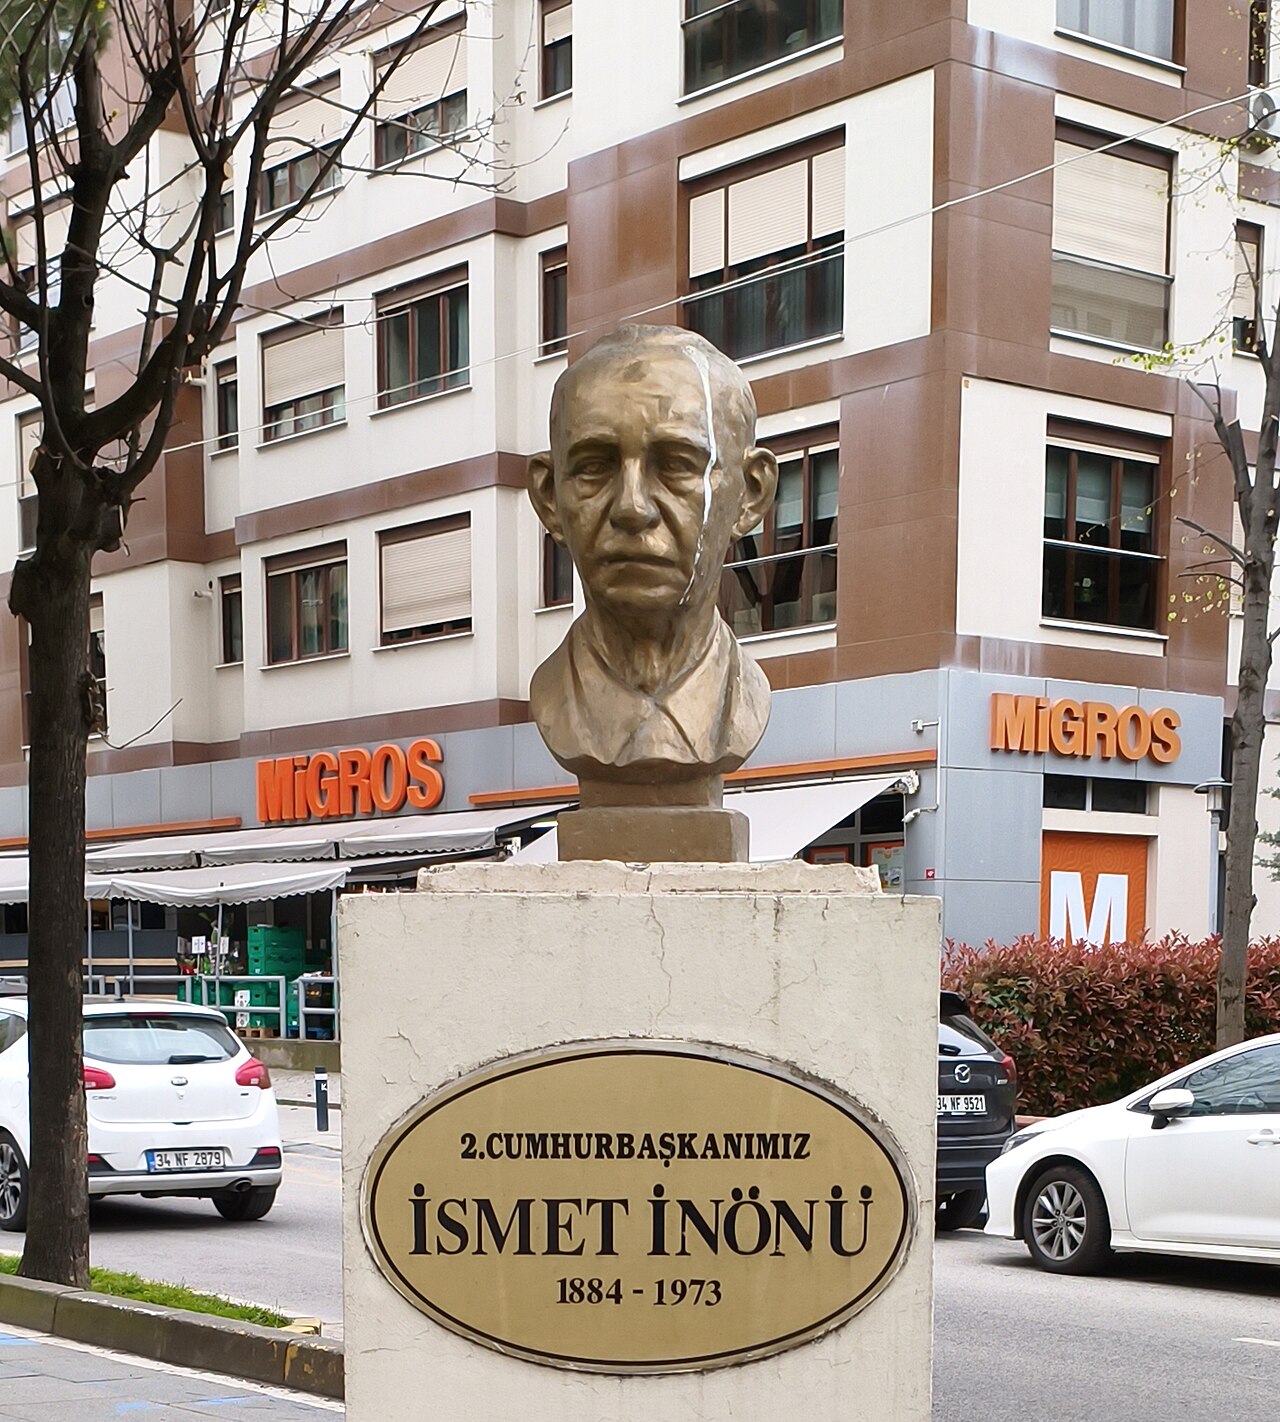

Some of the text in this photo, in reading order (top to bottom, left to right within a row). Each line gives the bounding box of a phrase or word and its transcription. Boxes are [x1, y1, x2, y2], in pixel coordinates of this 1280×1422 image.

[1050, 870, 1129, 950] M
[950, 1097, 961, 1110] NF
[964, 1097, 984, 1110] 9521
[156, 1152, 221, 1167] 34 NF 2879
[460, 1132, 811, 1167] 2.CUMHURBAŞKANIMIZ
[408, 1183, 874, 1257] İSMET İNÖNÜ
[556, 1277, 623, 1305] 1884
[653, 1279, 722, 1306] 1973
